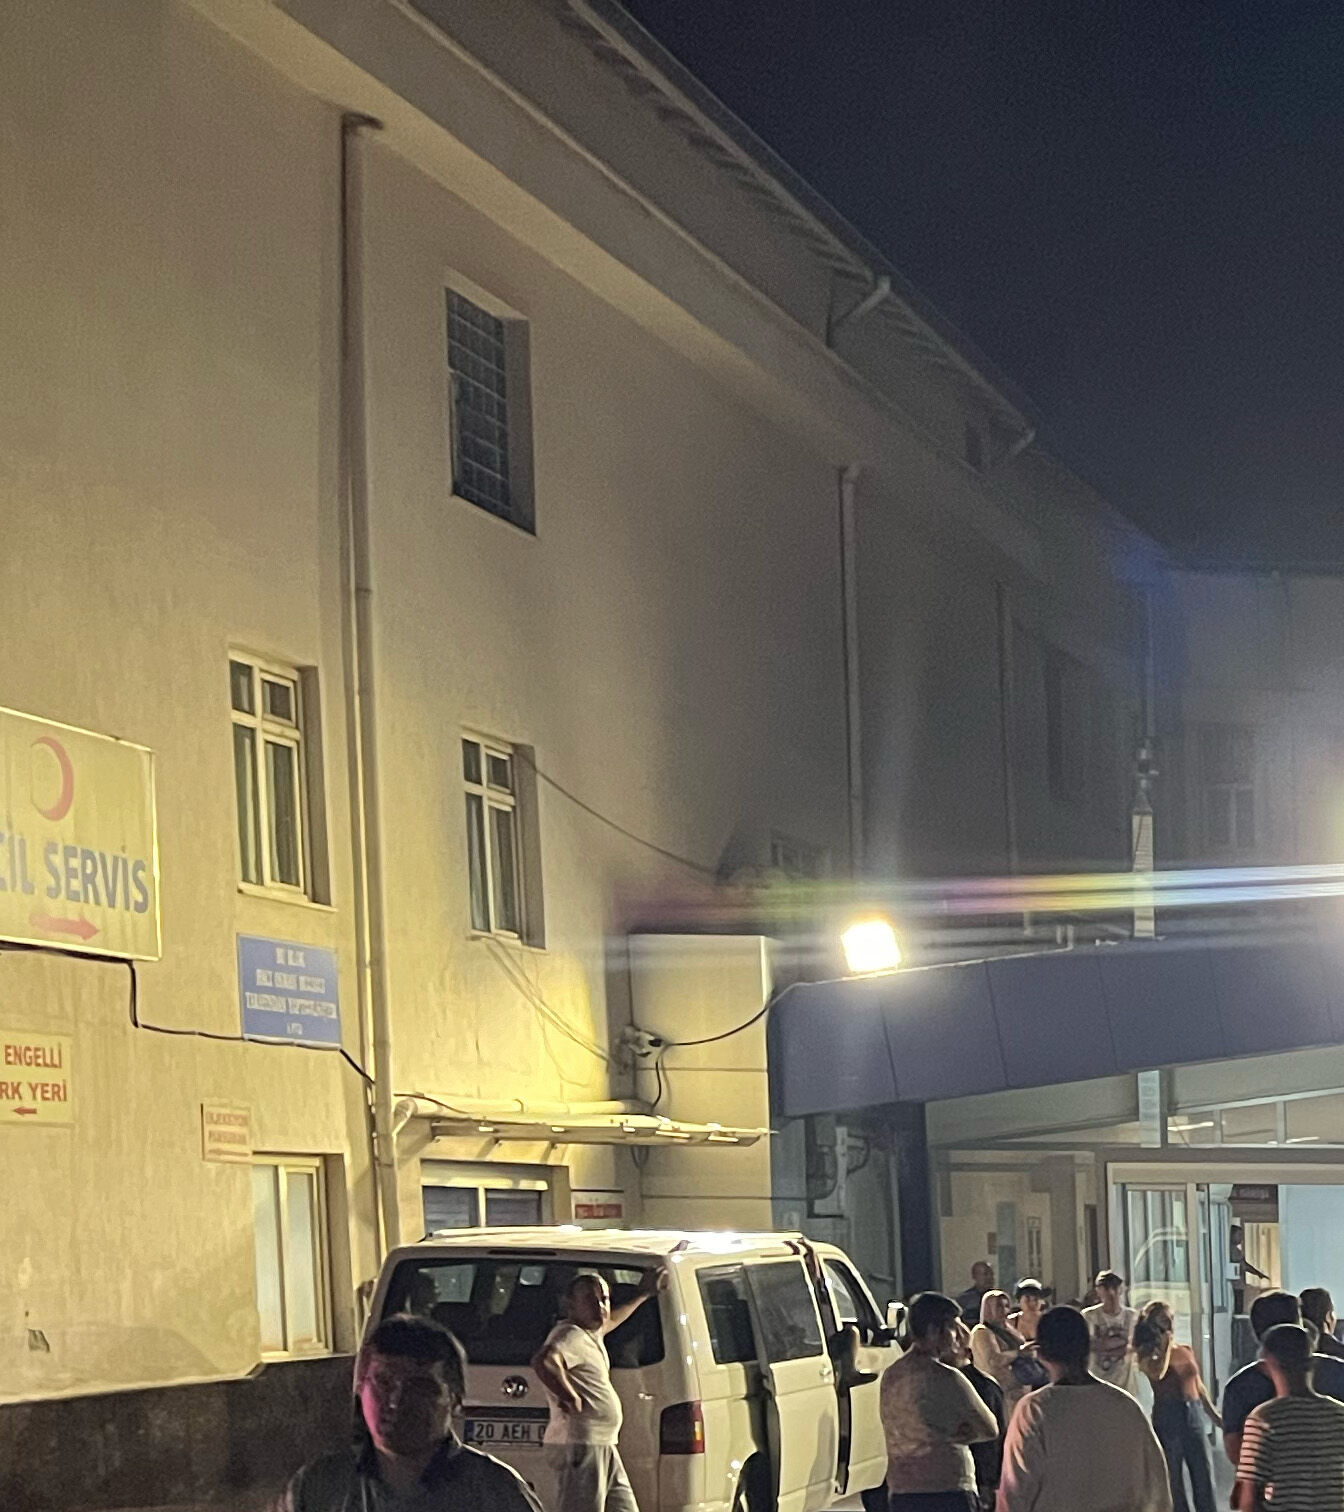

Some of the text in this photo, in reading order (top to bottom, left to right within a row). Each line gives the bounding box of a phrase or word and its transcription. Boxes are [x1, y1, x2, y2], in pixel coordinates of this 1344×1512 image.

[44, 841, 149, 914] SERVİS
[4, 1042, 62, 1069] ENGELLİ
[28, 1079, 67, 1102] YERİ
[475, 1423, 494, 1439] 20
[502, 1424, 531, 1440] AEH
